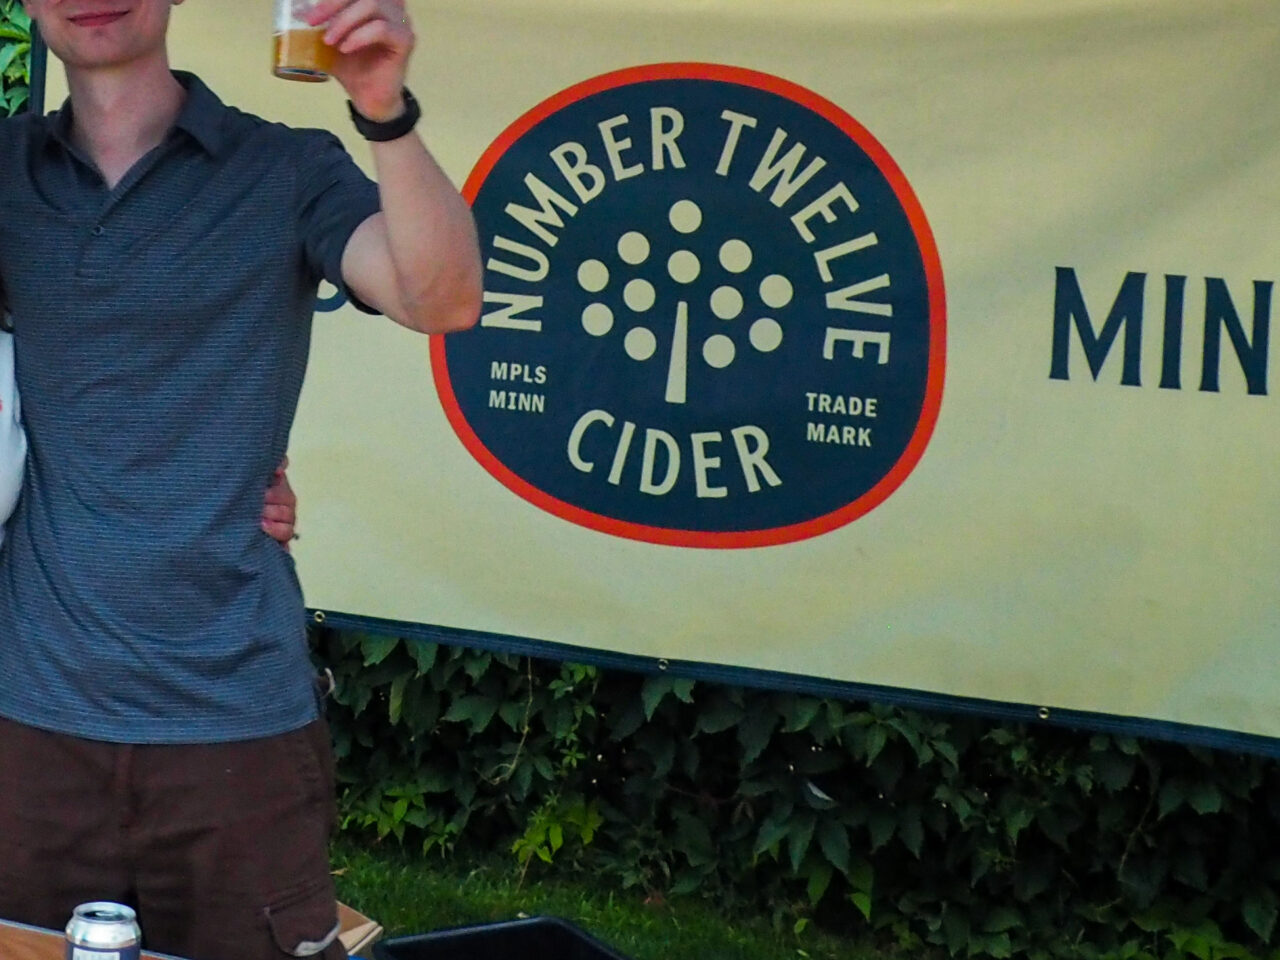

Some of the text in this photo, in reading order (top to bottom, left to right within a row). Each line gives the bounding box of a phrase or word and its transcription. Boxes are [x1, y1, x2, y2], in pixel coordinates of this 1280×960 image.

[481, 106, 894, 365] NUMBER TWELVE
[1048, 266, 1275, 397] MIN
[490, 361, 548, 386] MPLS
[488, 389, 546, 413] MINN
[805, 393, 878, 419] TRADE
[806, 421, 873, 448] MARK
[567, 410, 782, 499] CIDER
